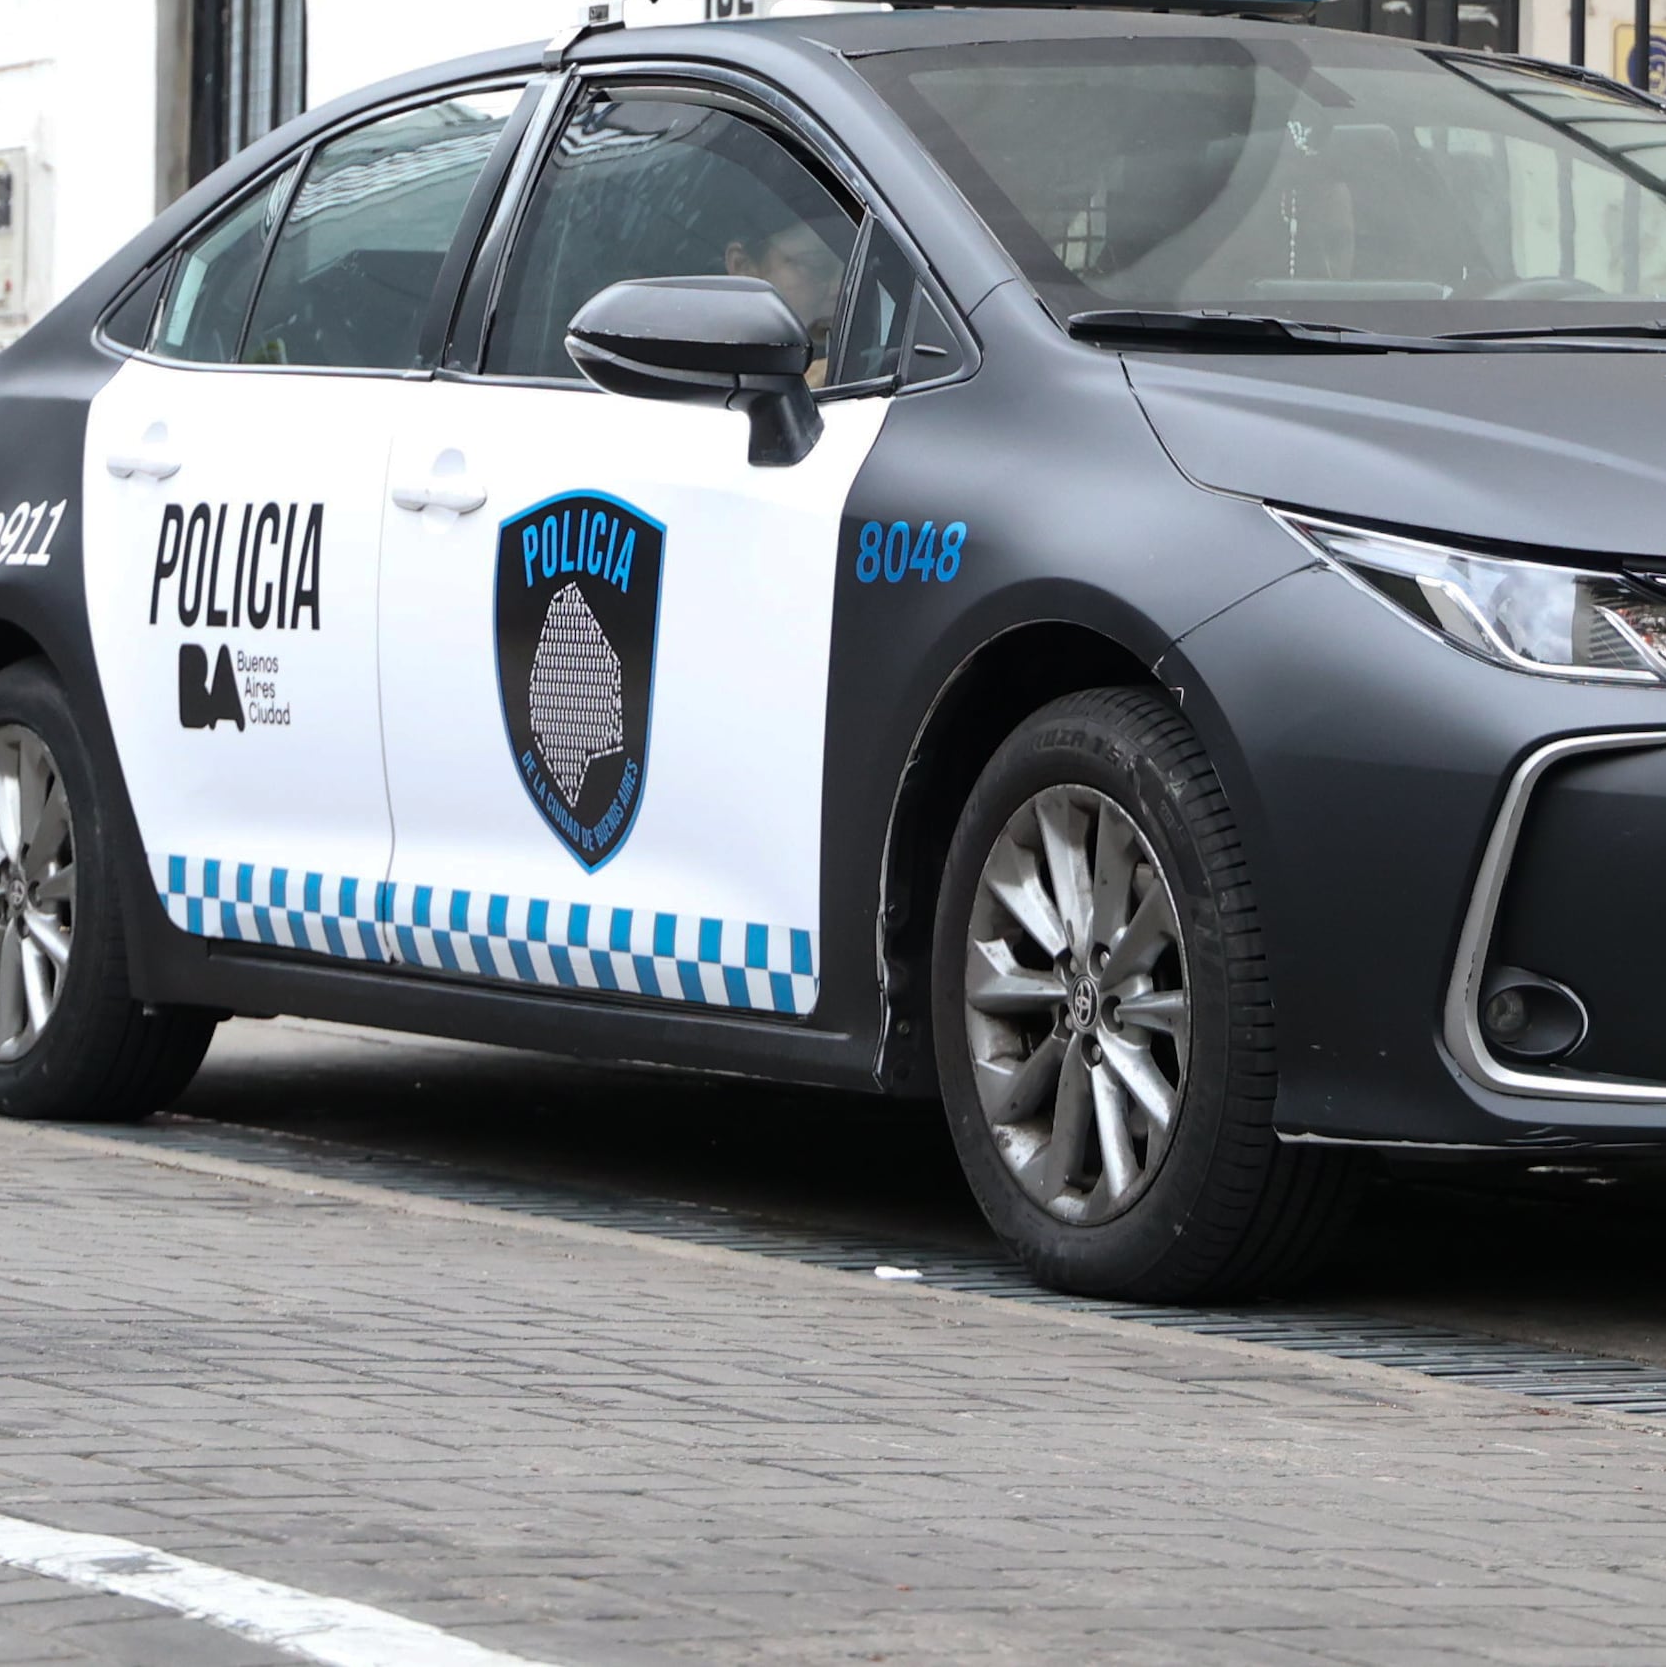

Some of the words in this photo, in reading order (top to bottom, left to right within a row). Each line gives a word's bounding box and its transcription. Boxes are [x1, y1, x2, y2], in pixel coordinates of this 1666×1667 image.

[149, 502, 324, 630] POLICIA
[522, 508, 636, 594] POLICIA
[856, 520, 967, 583] 8048
[179, 643, 245, 732] BA
[236, 650, 279, 673] Buenos
[244, 676, 275, 698] Aires
[248, 701, 291, 725] Ciudad
[522, 750, 537, 778] DE
[533, 772, 547, 799] LA
[546, 792, 581, 842] CIUDAD
[581, 827, 595, 851] DE
[593, 798, 624, 848] BUENOS
[617, 757, 638, 808] AIRES
